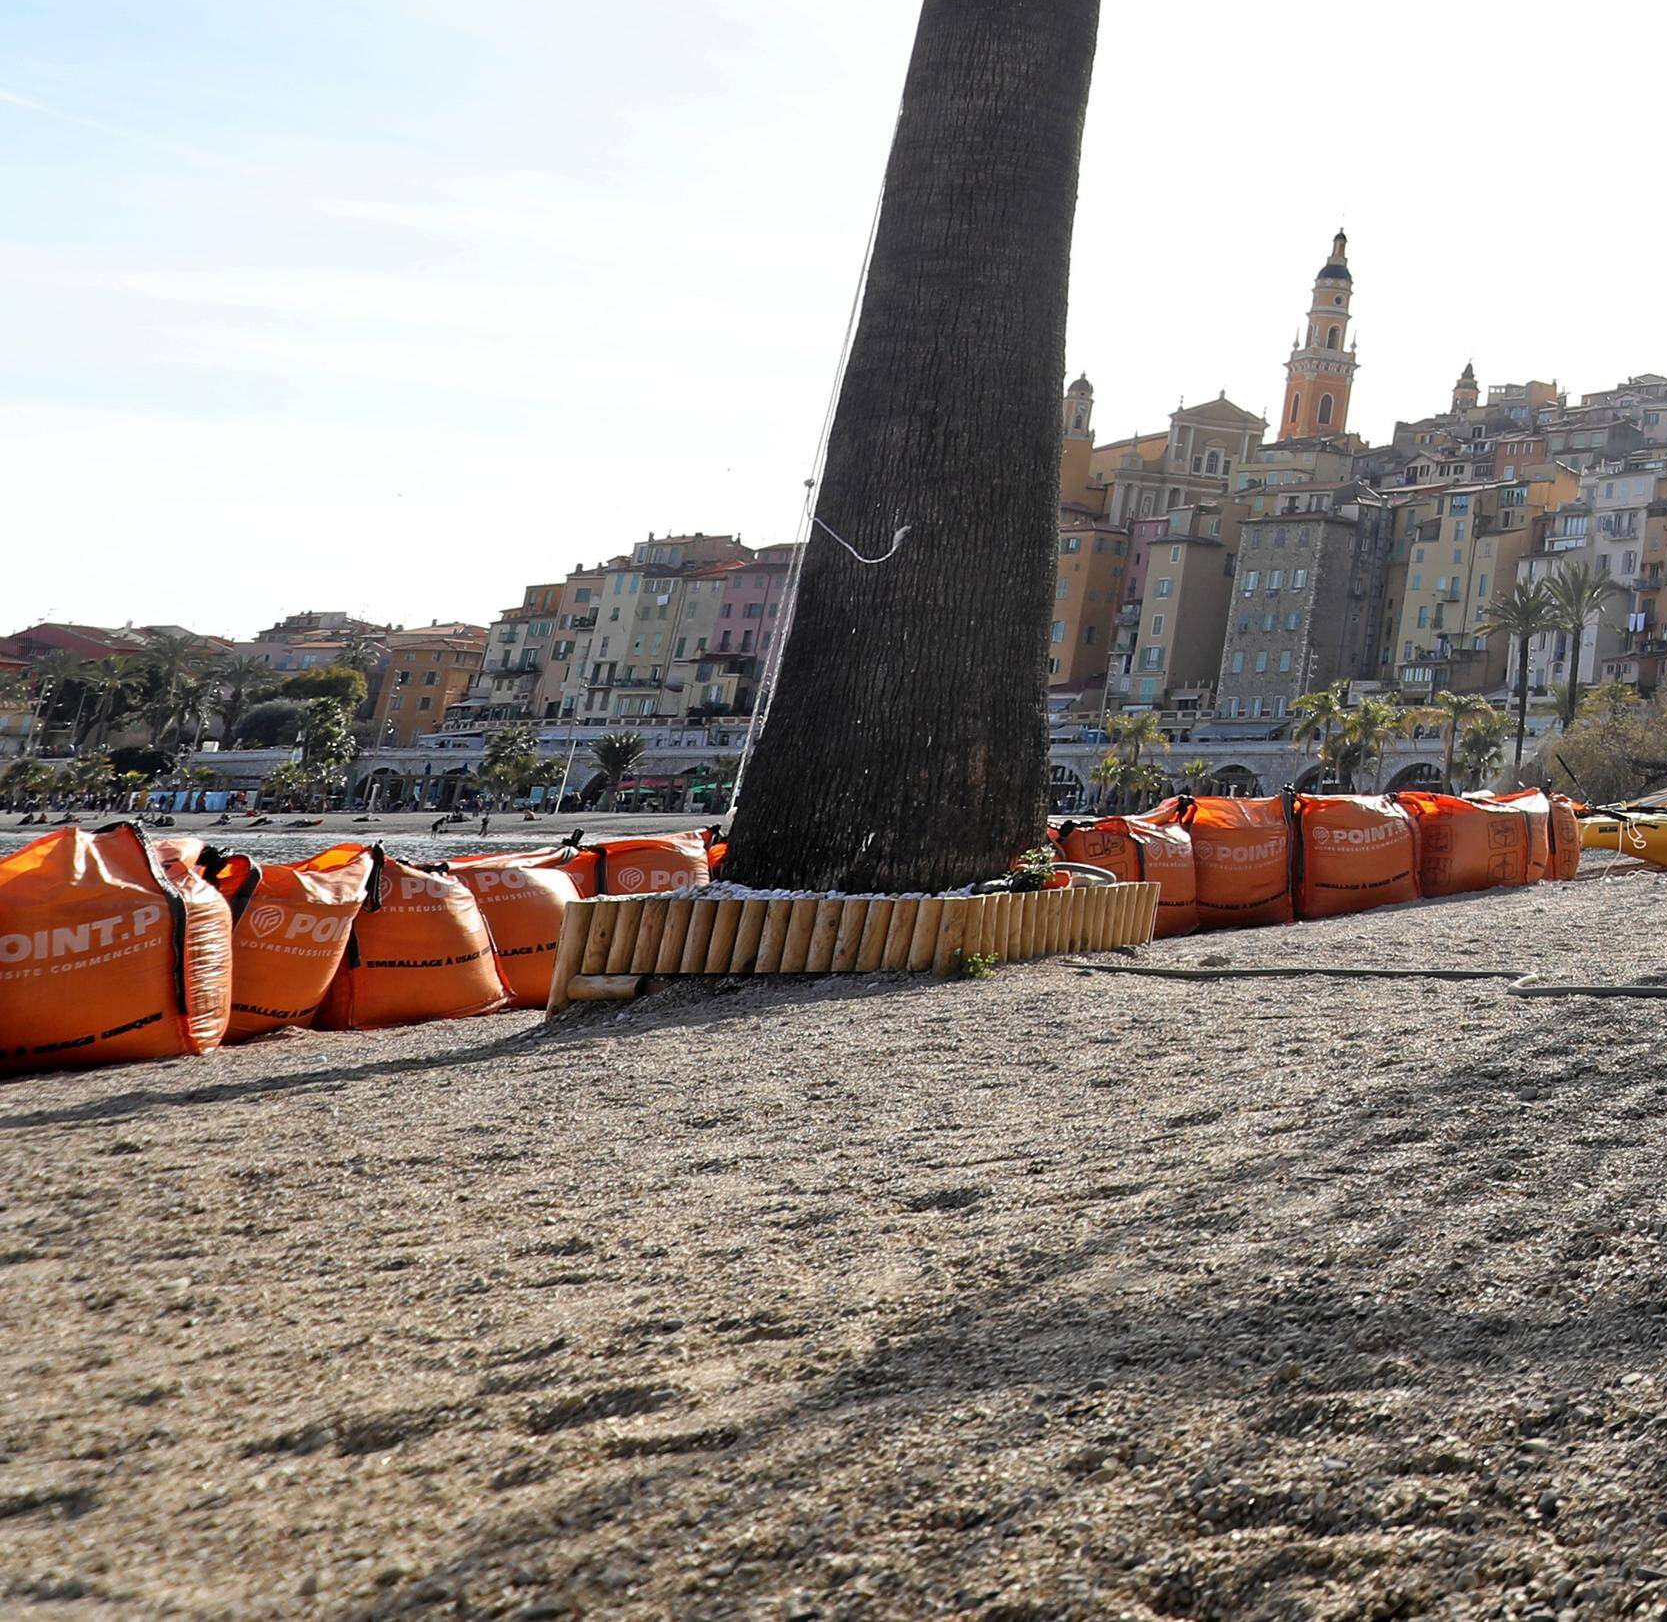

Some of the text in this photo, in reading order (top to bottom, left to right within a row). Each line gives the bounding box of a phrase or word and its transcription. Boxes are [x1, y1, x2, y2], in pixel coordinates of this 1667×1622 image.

[51, 943, 140, 974] COMMENCE
[144, 938, 162, 950] ICI
[367, 959, 443, 969] EMBALLAGE
